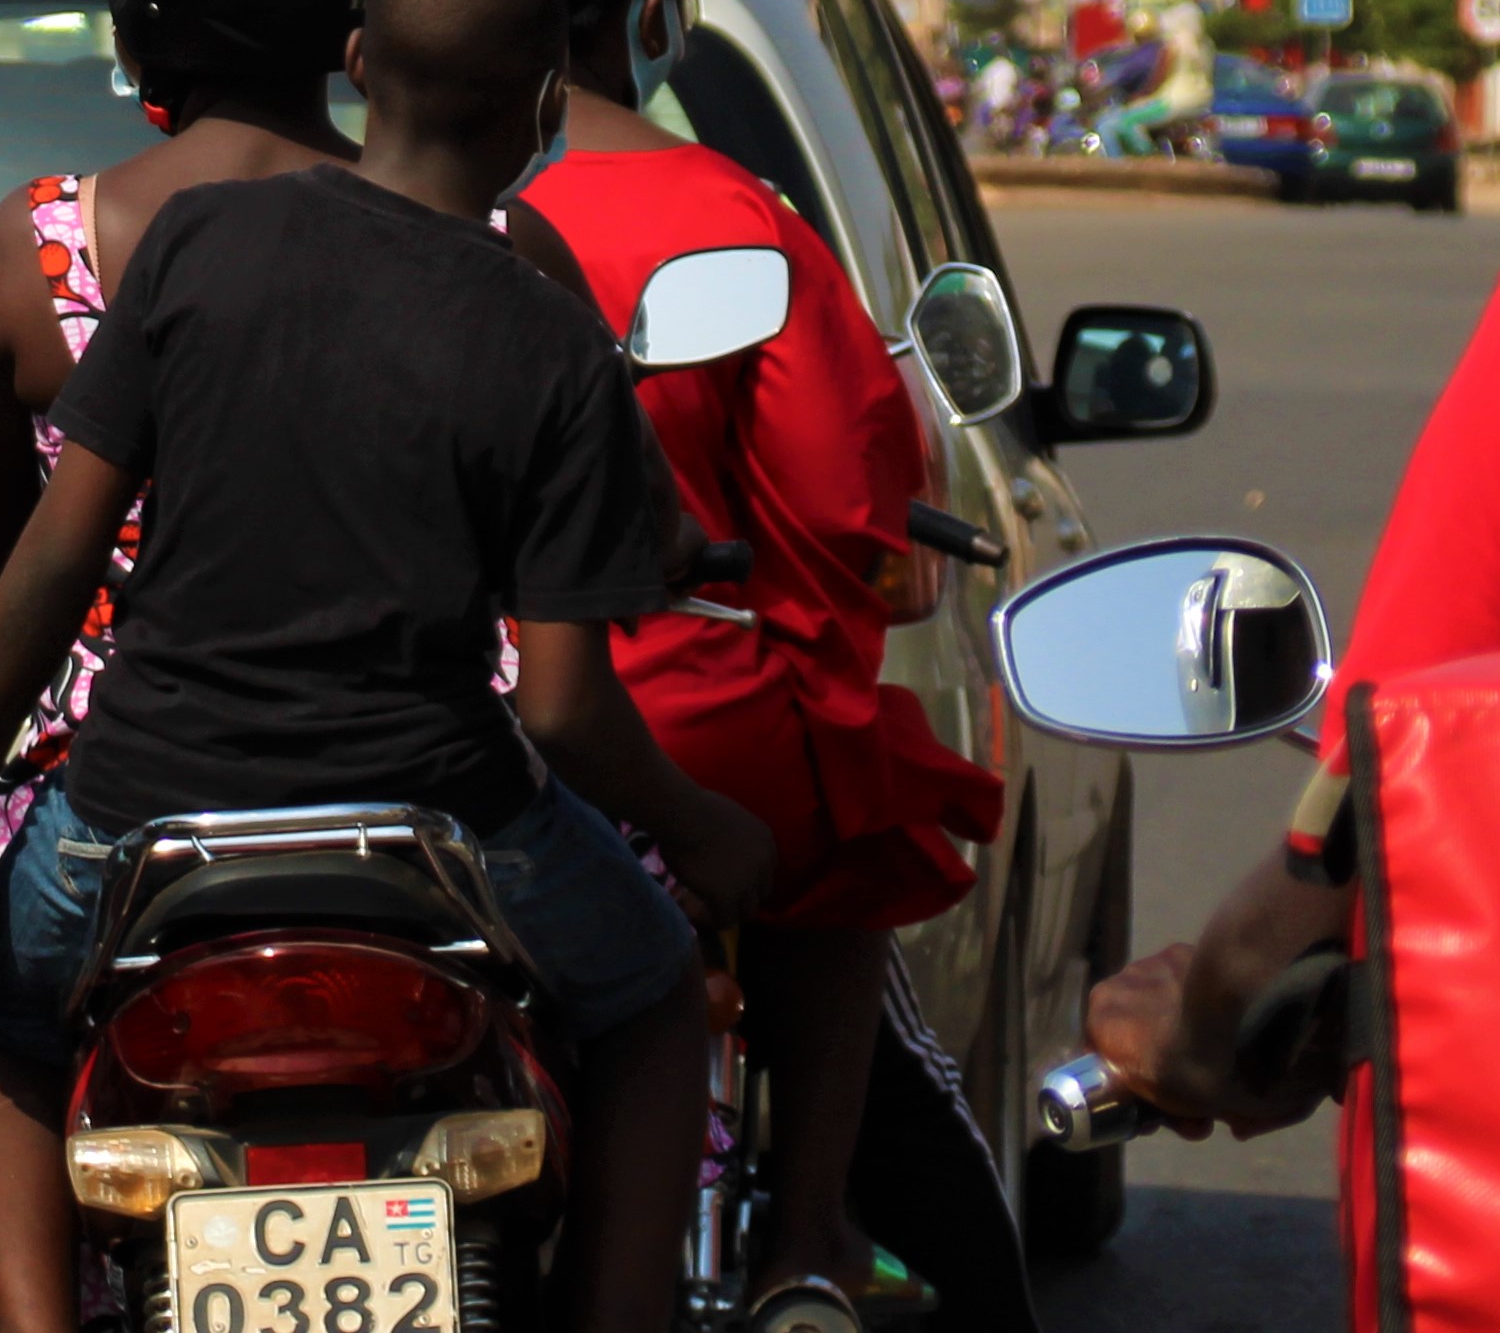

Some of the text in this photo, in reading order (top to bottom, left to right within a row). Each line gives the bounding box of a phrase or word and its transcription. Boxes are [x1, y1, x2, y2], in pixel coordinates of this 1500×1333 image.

[253, 1196, 371, 1267] CA
[393, 1242, 434, 1267] TG
[192, 1271, 441, 1333] 0382
